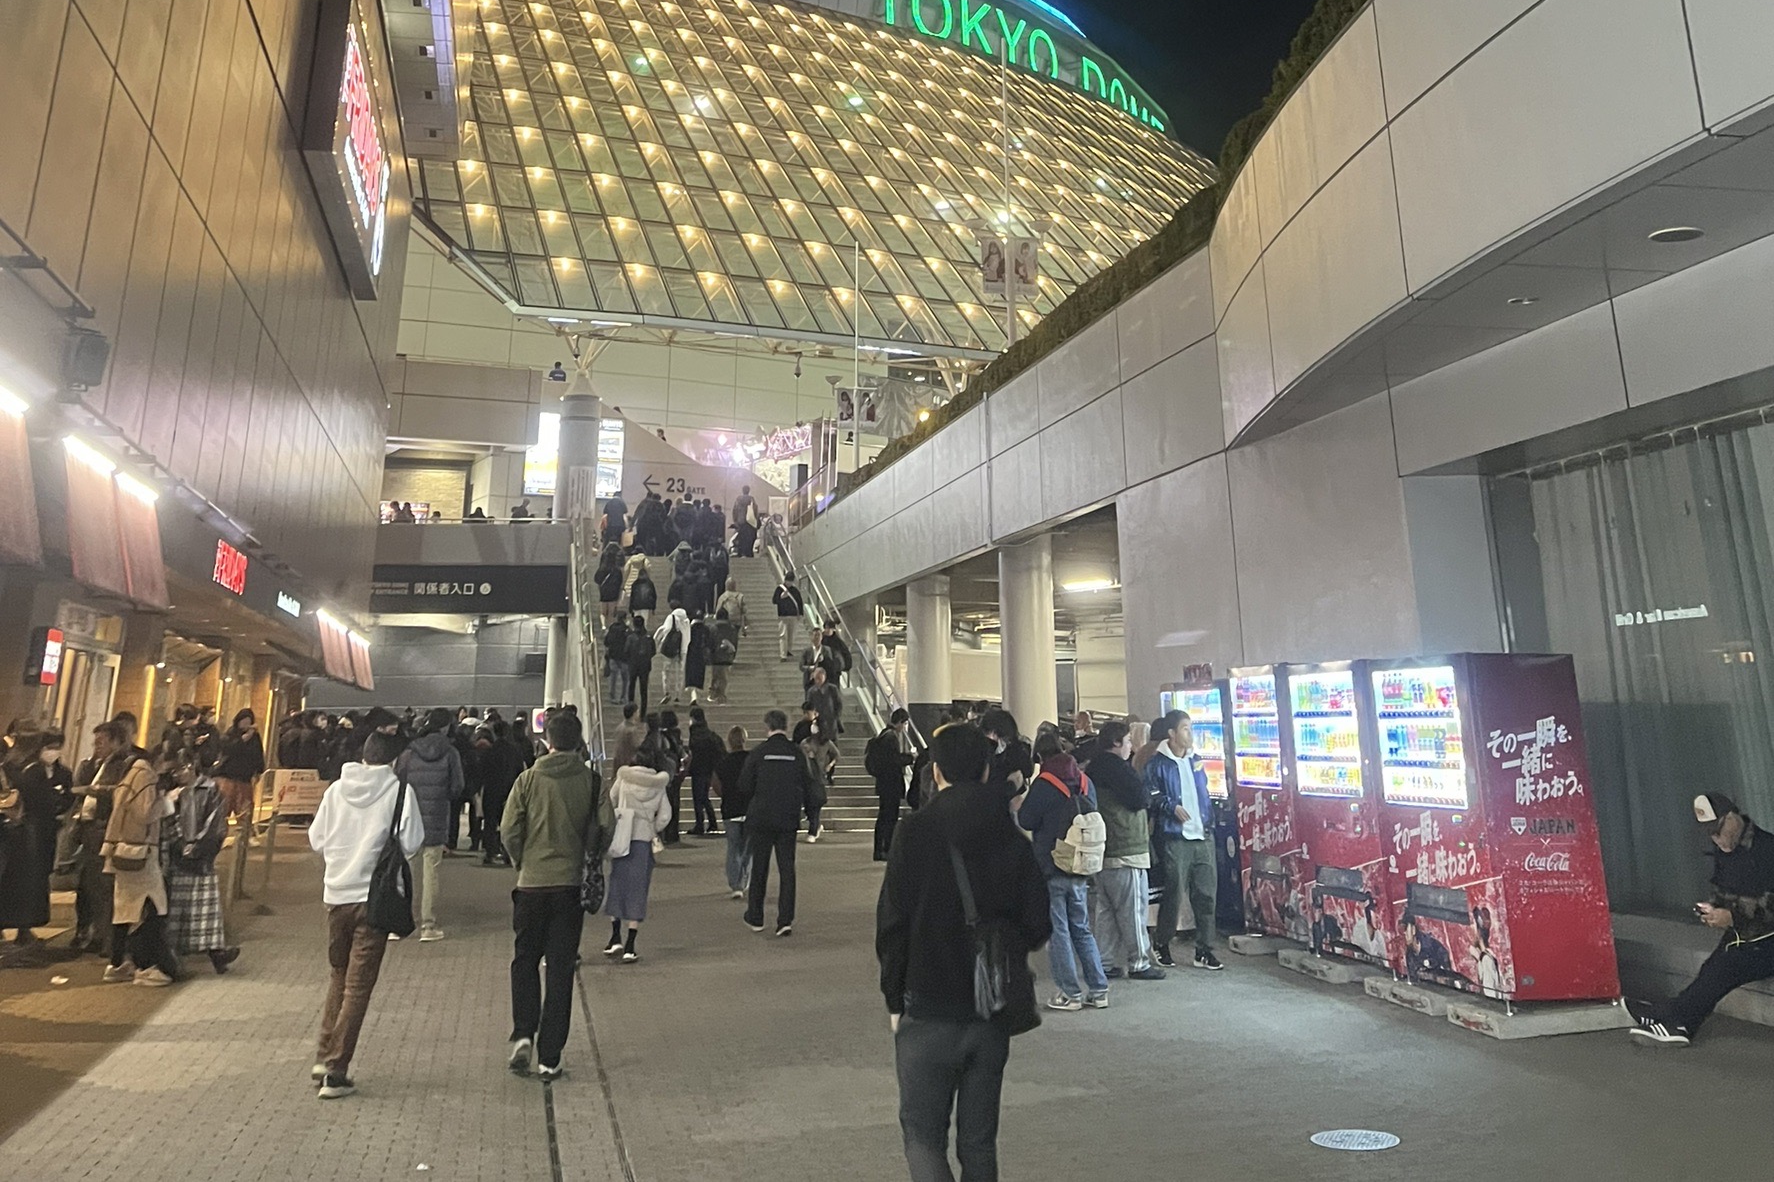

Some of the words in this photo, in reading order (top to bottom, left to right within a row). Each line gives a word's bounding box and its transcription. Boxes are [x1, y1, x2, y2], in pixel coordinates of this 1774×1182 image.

[666, 477, 685, 493] 23
[687, 486, 706, 495] GATE
[413, 582, 475, 595] 関係者入口
[1486, 715, 1573, 758] その一瞬を、
[1501, 743, 1554, 775] 一緒に
[1515, 770, 1584, 806] 味わおう。
[1530, 819, 1576, 835] JAPAN
